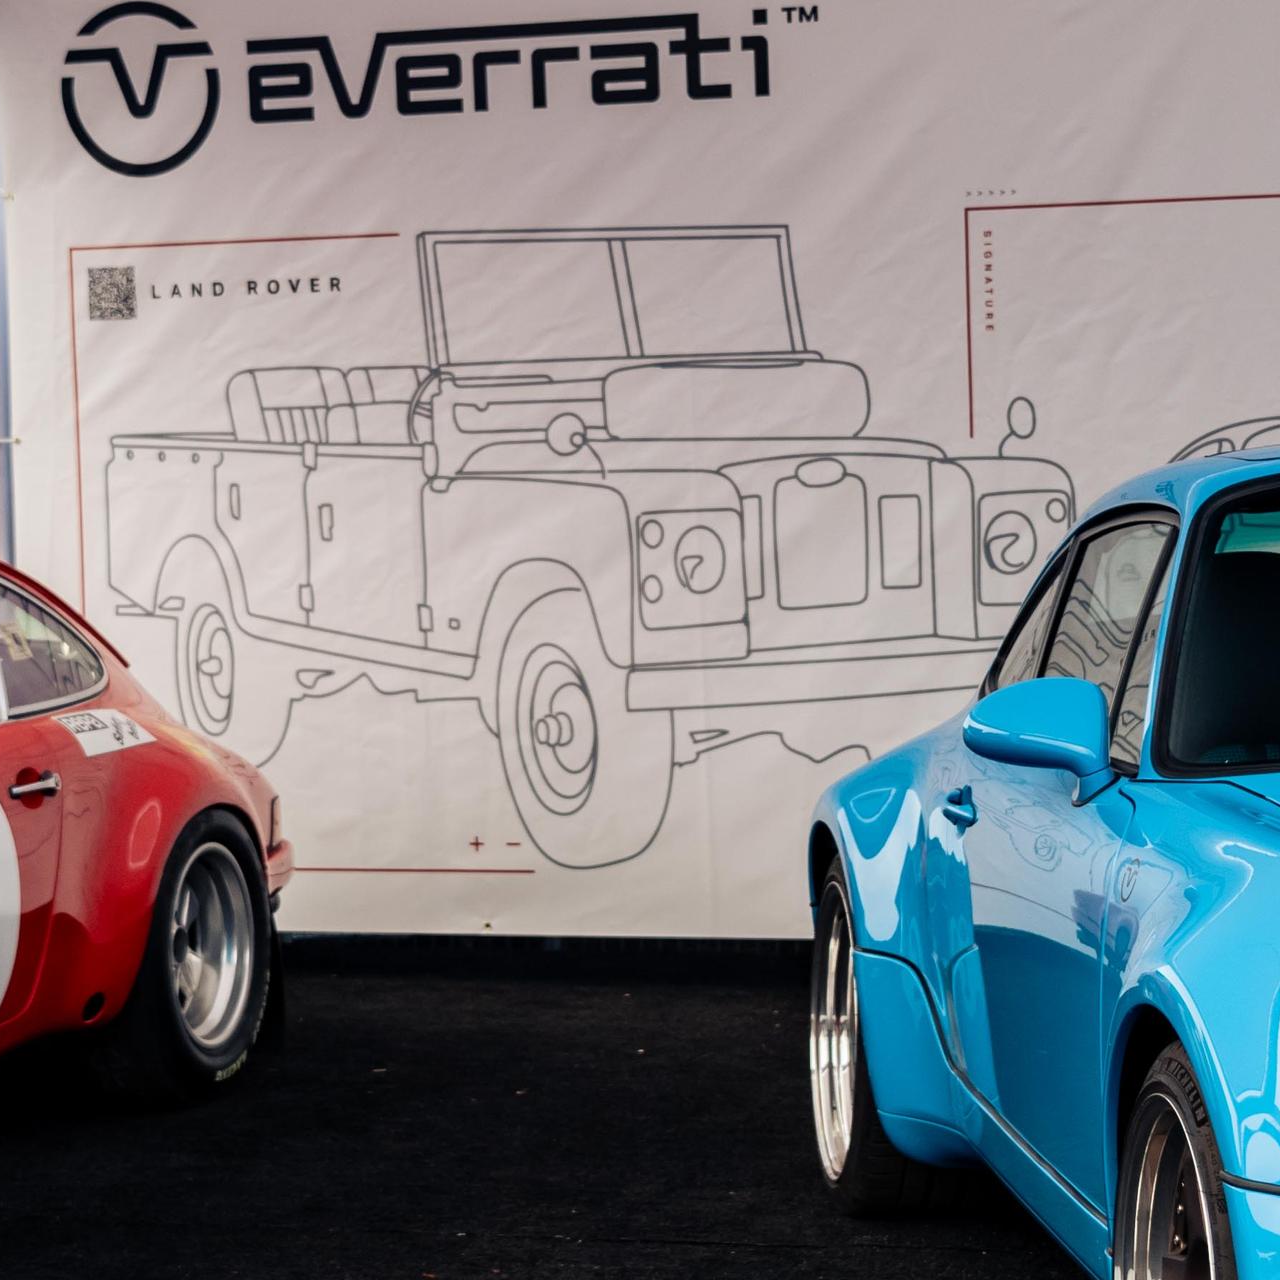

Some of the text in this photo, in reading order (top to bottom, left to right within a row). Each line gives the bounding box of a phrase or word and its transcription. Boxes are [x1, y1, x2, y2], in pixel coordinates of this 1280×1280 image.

[151, 277, 342, 299] LAND ROVER
[983, 230, 994, 331] SIGNATURE
